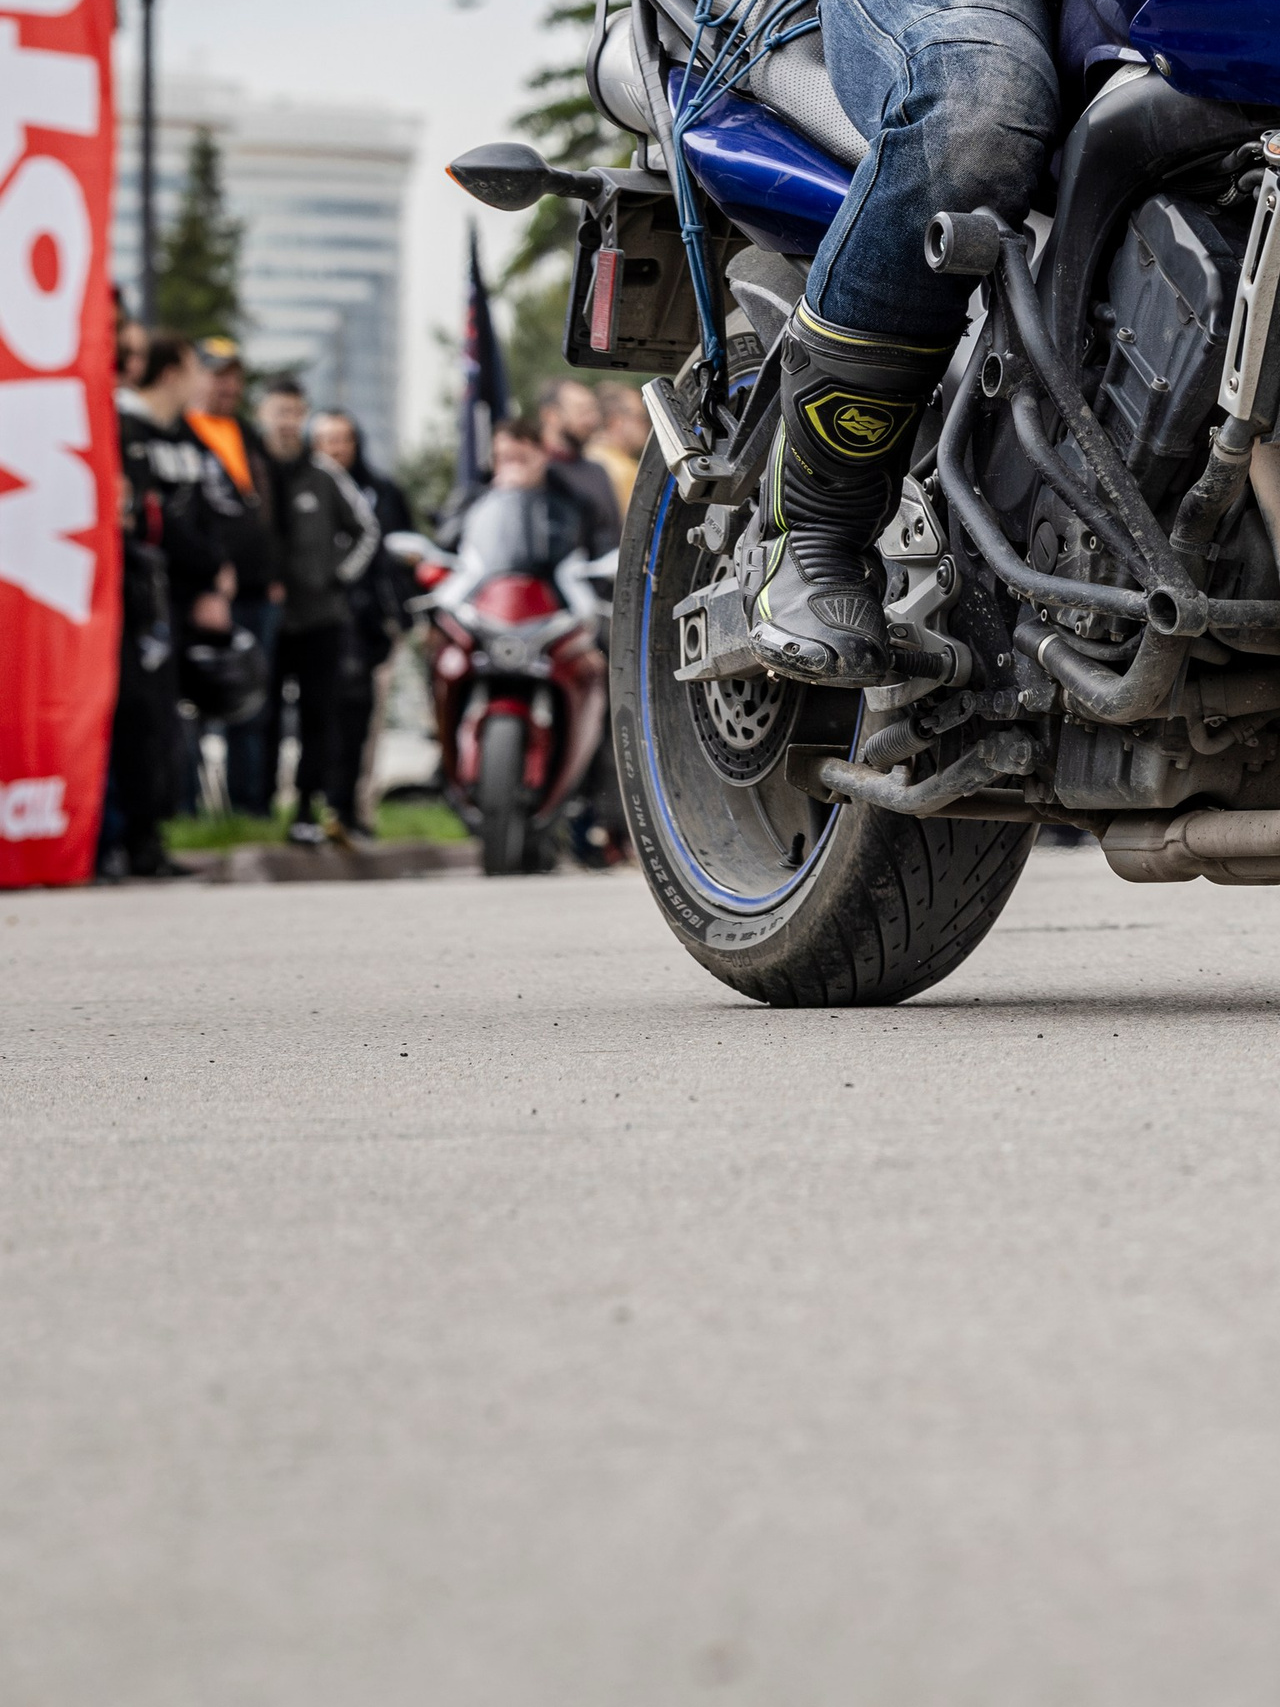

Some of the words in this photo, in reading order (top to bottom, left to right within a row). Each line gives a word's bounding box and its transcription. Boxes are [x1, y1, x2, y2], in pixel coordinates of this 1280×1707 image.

[640, 834, 653, 853] 17
[649, 856, 670, 883] ZR
[662, 885, 704, 930] 180/55
